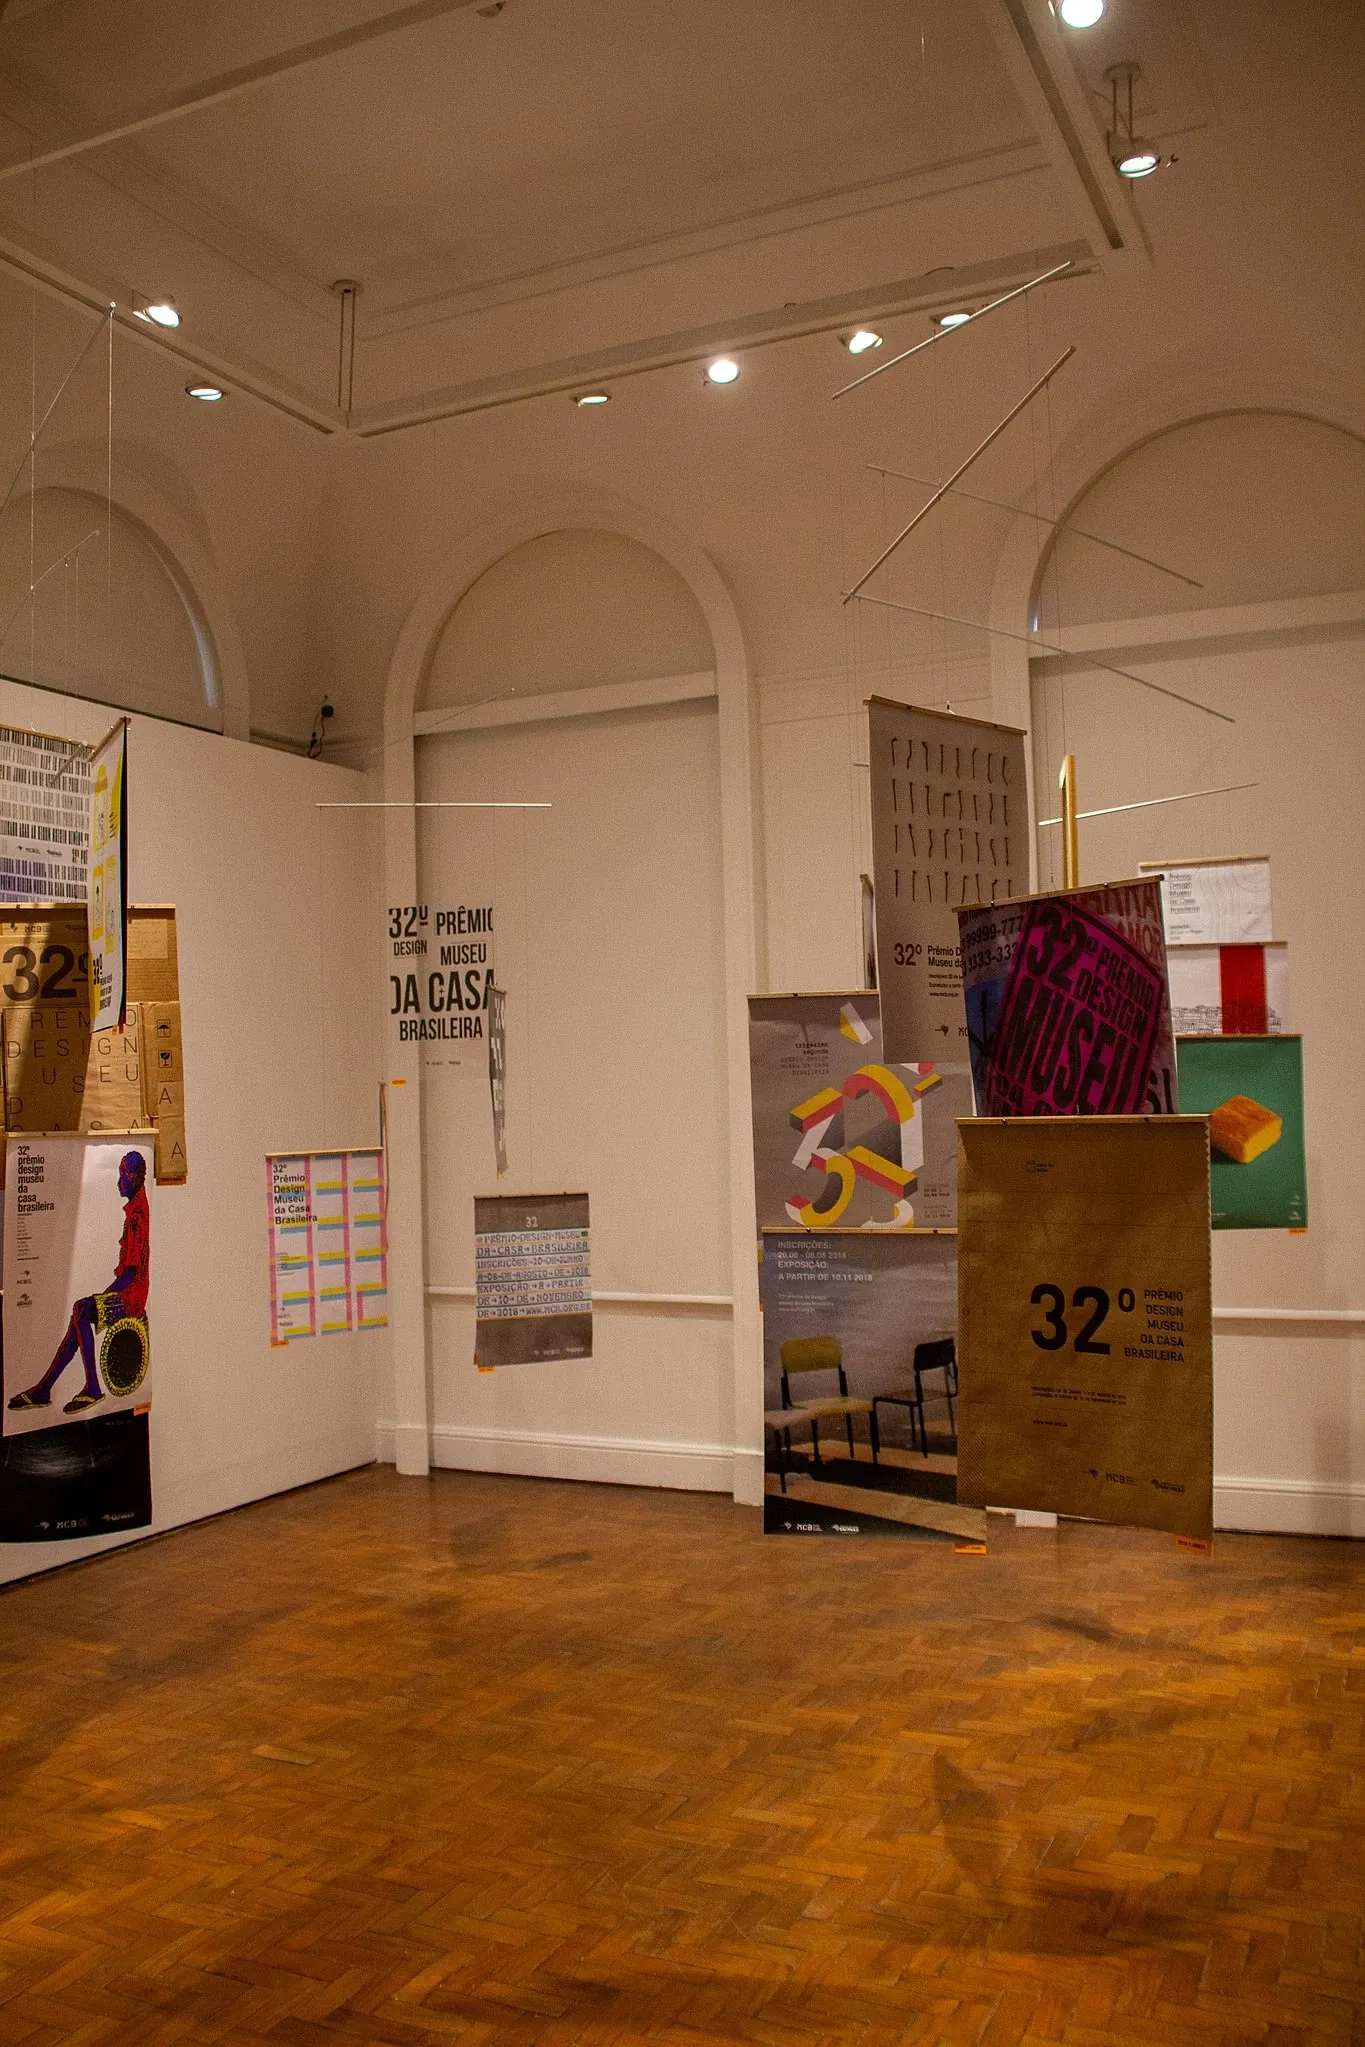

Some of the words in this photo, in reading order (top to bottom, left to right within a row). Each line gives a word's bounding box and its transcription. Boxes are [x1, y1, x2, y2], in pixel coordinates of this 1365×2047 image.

[393, 939, 428, 956] DESIGN
[440, 943, 487, 966] MUSEU
[893, 943, 922, 966] 32º
[927, 945, 954, 957] Prêmio
[928, 957, 953, 968] Museu
[429, 968, 494, 1012] CASA
[1075, 967, 1148, 1034] DESIGN
[399, 1016, 483, 1041] BRASILEIRA
[17, 1155, 45, 1167] prêmio
[17, 1165, 44, 1178] design
[272, 1164, 288, 1173] 32º
[17, 1175, 44, 1184] museu
[273, 1173, 305, 1184] Prêmio
[17, 1184, 28, 1193] da
[273, 1184, 305, 1195] Design
[17, 1194, 37, 1203] casa
[274, 1194, 304, 1204] Museu
[17, 1201, 55, 1212] brasileira
[274, 1204, 286, 1215] da
[288, 1203, 311, 1213] Casa
[275, 1213, 318, 1225] Brasileira
[525, 1216, 539, 1228] 32
[476, 1246, 492, 1257] DA
[497, 1244, 524, 1256] CASA
[531, 1241, 588, 1254] BRASILEIRA
[777, 1240, 832, 1250] INSCRIÇÕES:
[777, 1259, 830, 1270] EXPOSIÇÃO:
[786, 1273, 816, 1281] PARTIR
[818, 1273, 829, 1281] DE
[1145, 1304, 1184, 1317] DESIGN
[1030, 1283, 1136, 1356] 32º
[1144, 1287, 1184, 1302] PRÊMIO
[1147, 1319, 1184, 1332] MUSEU
[1140, 1333, 1155, 1345] DA
[1158, 1335, 1185, 1347] CASA
[1124, 1347, 1185, 1362] BRASILEIRA
